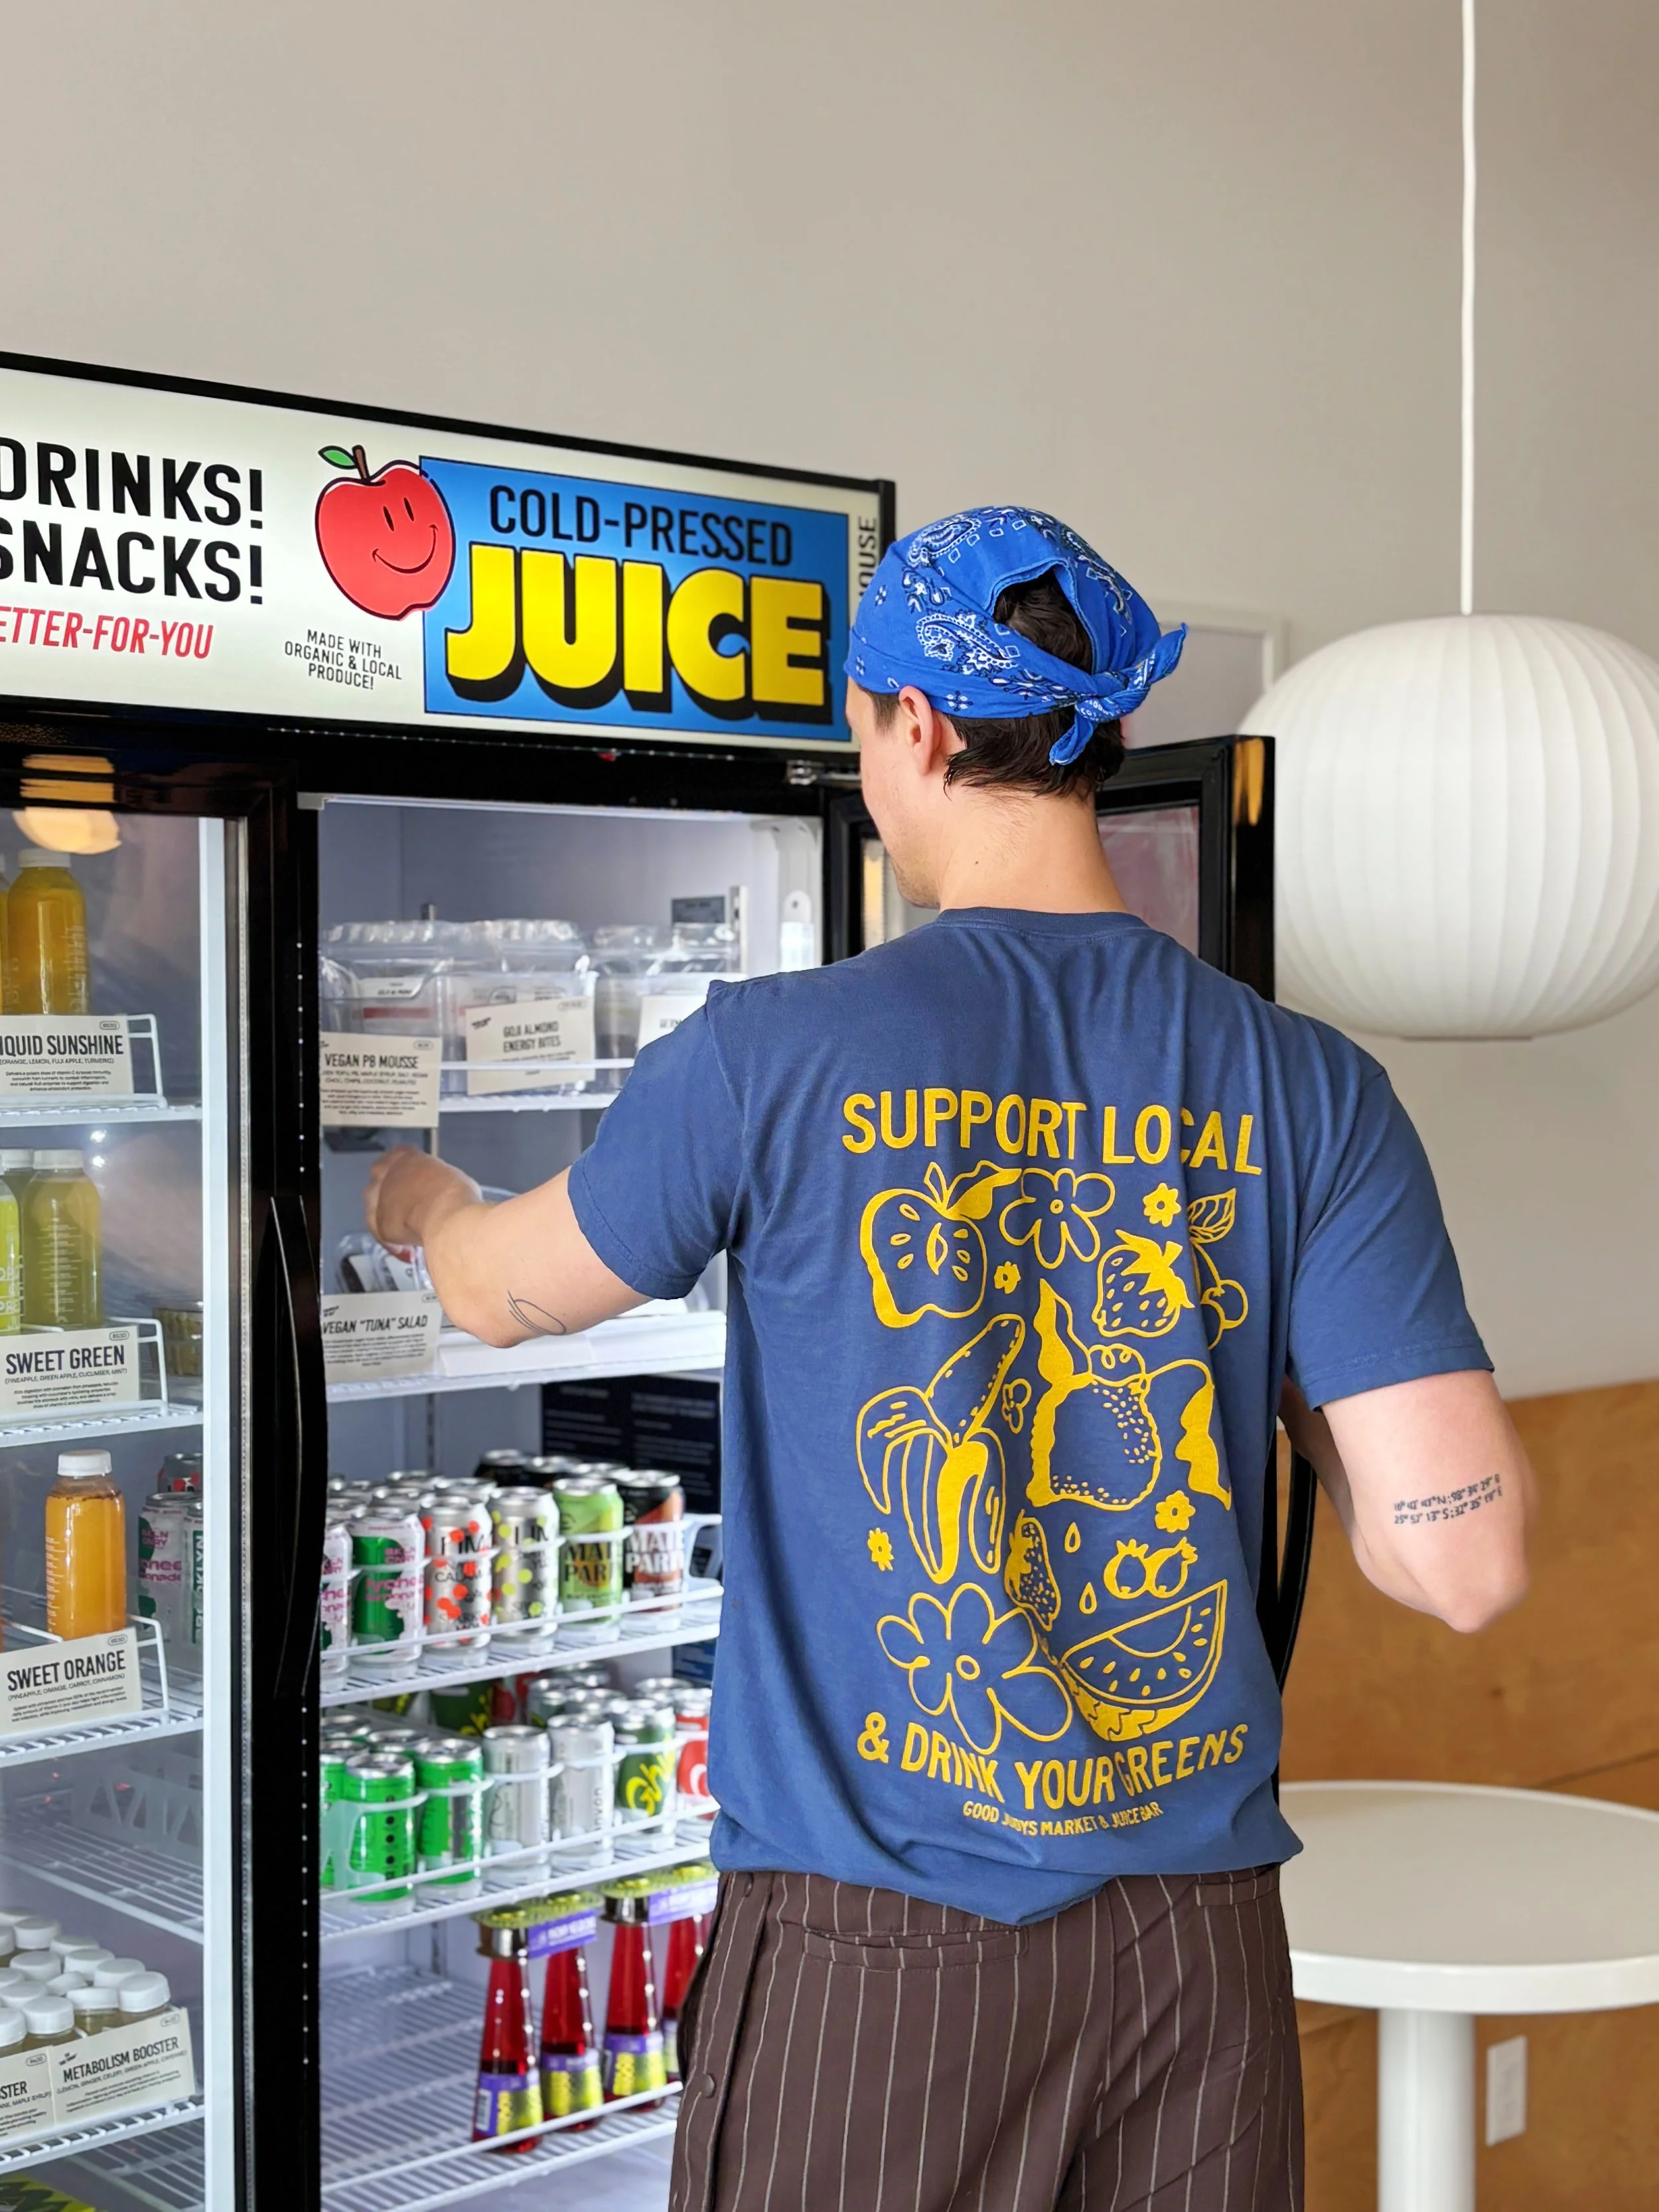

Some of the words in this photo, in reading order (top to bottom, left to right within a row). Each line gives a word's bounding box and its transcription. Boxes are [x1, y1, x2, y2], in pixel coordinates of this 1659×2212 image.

[0, 436, 263, 529] DRINKS!
[490, 485, 792, 567] COLD-PRESSED
[858, 516, 878, 596] OUSE
[307, 629, 344, 650] MADE
[349, 638, 381, 658] WITH
[445, 542, 831, 721] JUICE
[285, 641, 343, 666] ORGANIC
[348, 655, 357, 670] &
[362, 658, 402, 680] LOCAL
[309, 663, 374, 690] PRODUCE!
[47, 1035, 124, 1055] SUNSHINE
[325, 1053, 359, 1068] VEGAN
[363, 1054, 376, 1069] PB
[380, 1055, 419, 1069] MOUSSE
[842, 1088, 1087, 1159] SUPPORT
[323, 1320, 356, 1334] VEGAN
[399, 1315, 428, 1329] SALAD
[6, 1350, 65, 1374] SWEET
[70, 1345, 125, 1369] GREEN
[7, 1662, 60, 1692] SWEET
[64, 1650, 126, 1680] ORANGE
[857, 1712, 889, 1763] &
[901, 1722, 1005, 1804] DRINK
[1015, 1755, 1115, 1810] YOUR
[962, 1801, 999, 1822] GOOD
[1041, 1816, 1098, 1836] MARKET
[63, 2050, 130, 2083] METABOLISM
[133, 2037, 179, 2062] BOOSTER
